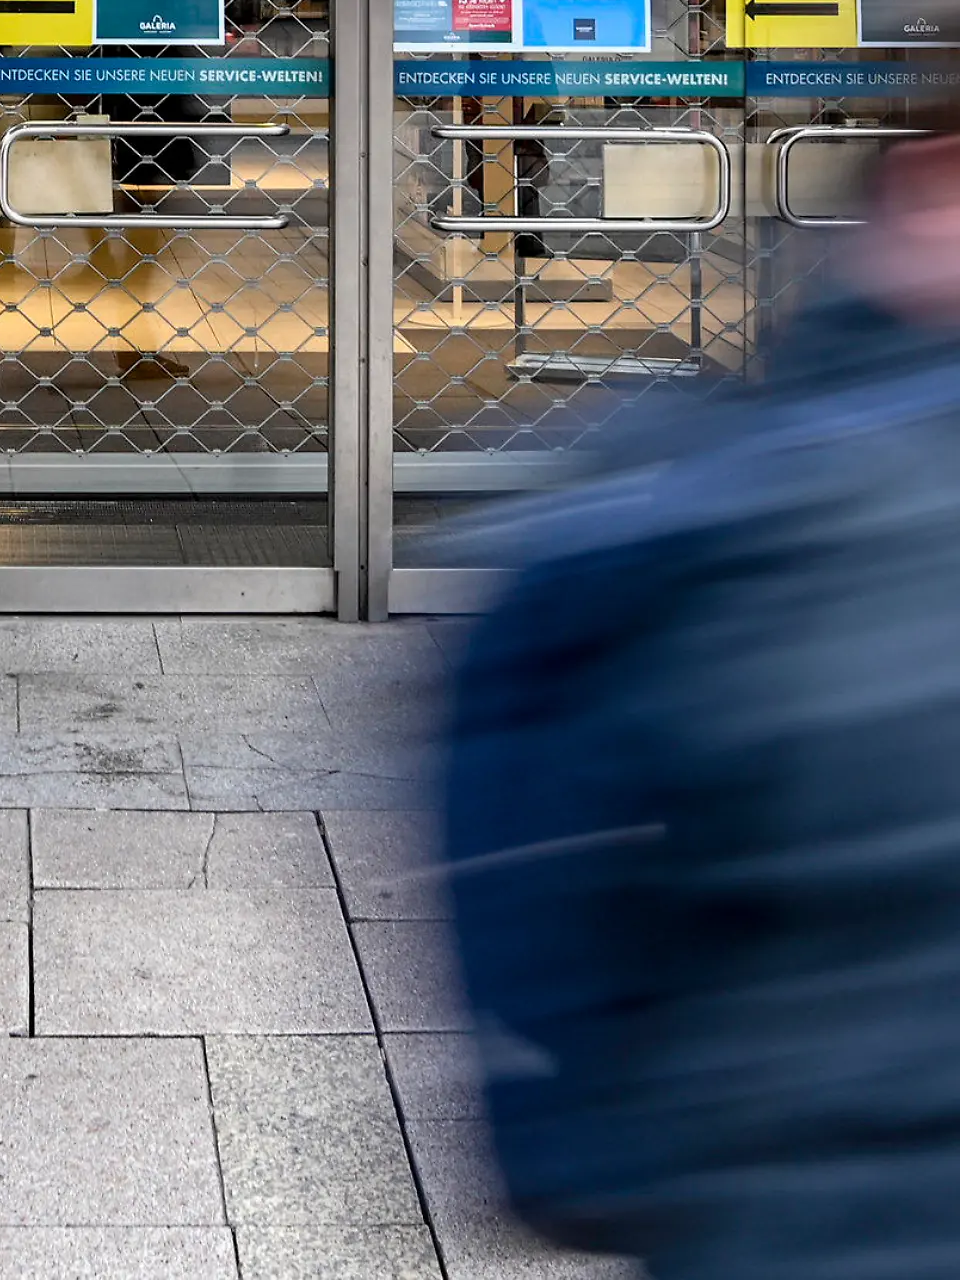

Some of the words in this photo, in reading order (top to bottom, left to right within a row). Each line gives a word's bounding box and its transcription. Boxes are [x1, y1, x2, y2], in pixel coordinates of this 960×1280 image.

[139, 22, 175, 31] GALERIA
[74, 69, 92, 81] SIE
[96, 69, 146, 82] UNSERE
[150, 69, 195, 82] NEUEN
[199, 70, 323, 83] SERVICE-WELTEN!
[398, 72, 475, 84] ENTDECKEN
[478, 72, 497, 85] SIE
[501, 72, 551, 85] UNSERE
[555, 73, 601, 85] NEUEN
[604, 73, 728, 86] SERVICE-WELTEN!
[766, 72, 842, 85] ENTDECKEN
[846, 73, 864, 85] SIE
[868, 73, 917, 85] UNSERE
